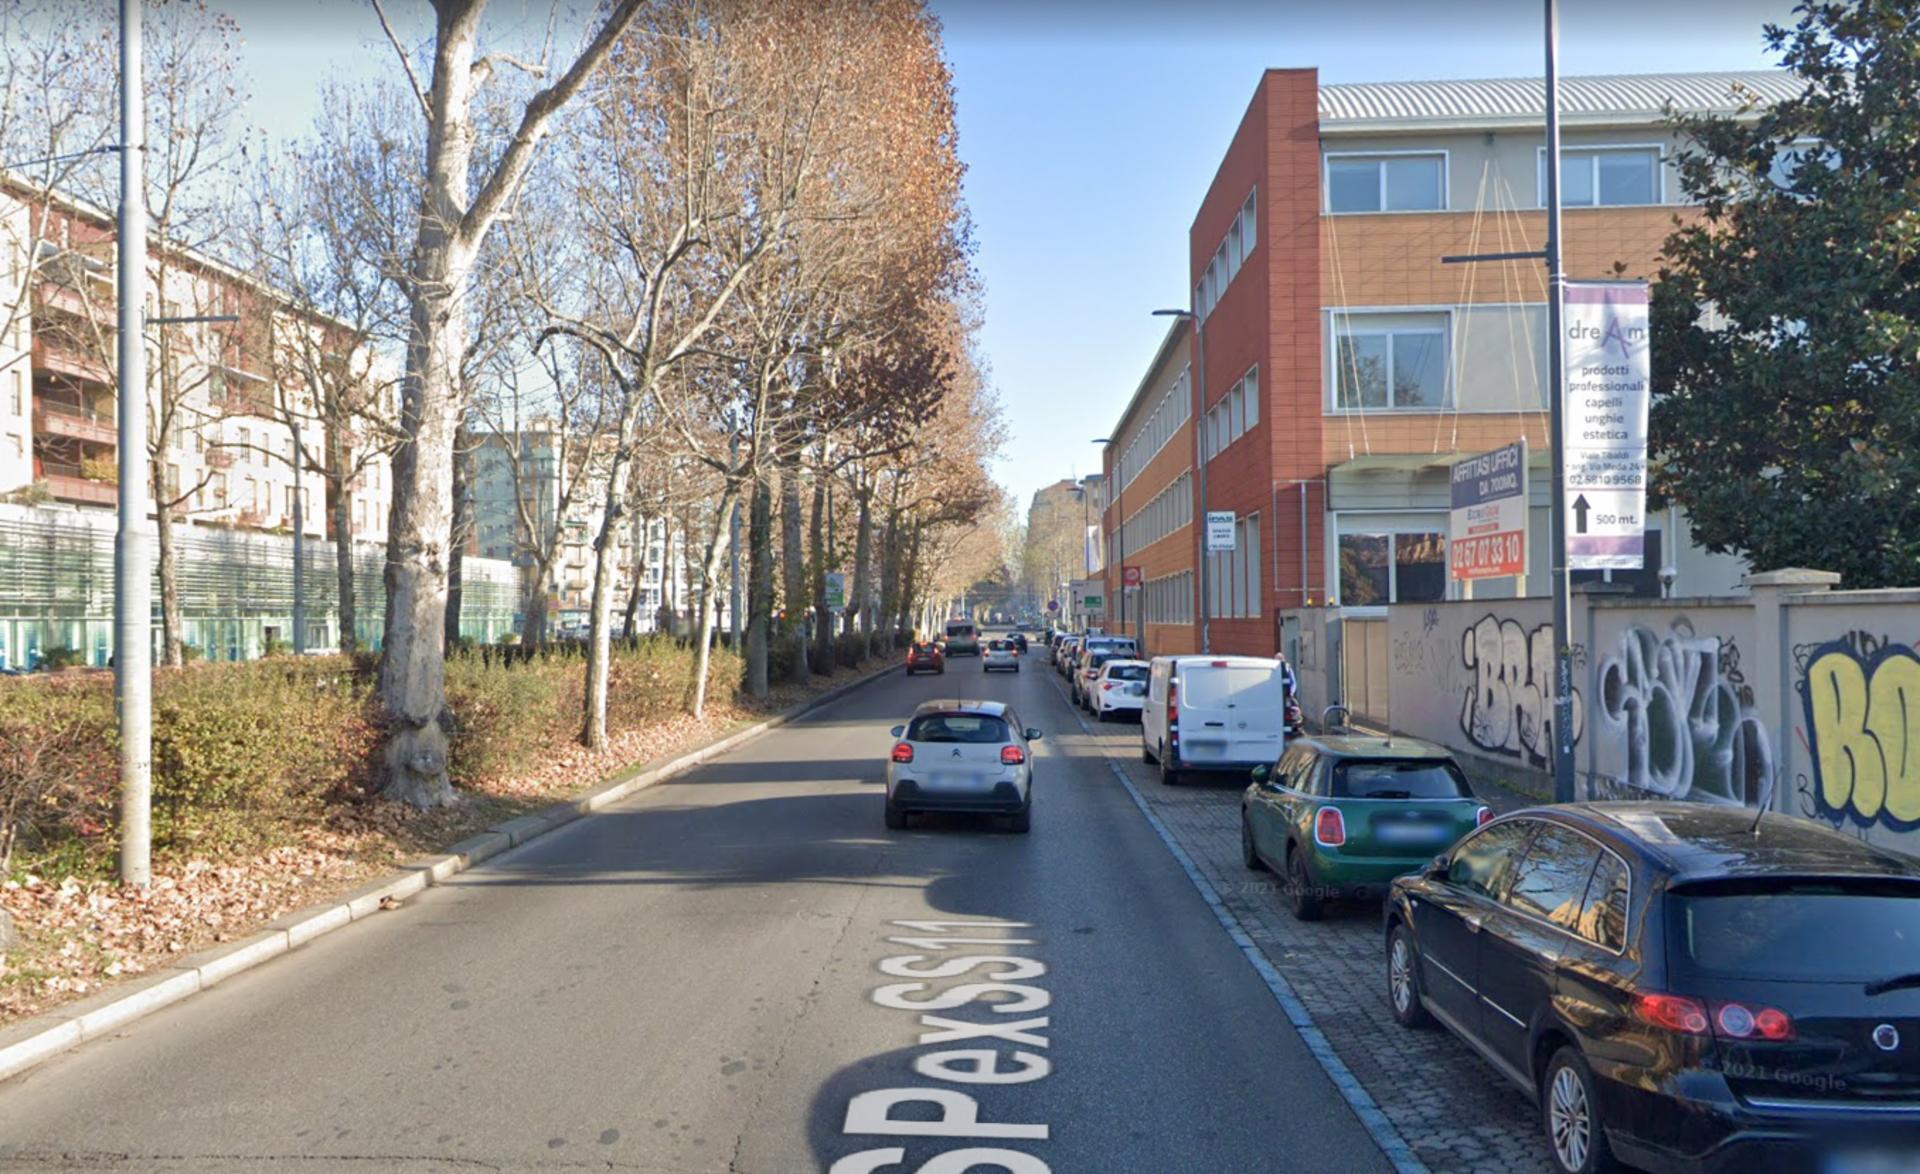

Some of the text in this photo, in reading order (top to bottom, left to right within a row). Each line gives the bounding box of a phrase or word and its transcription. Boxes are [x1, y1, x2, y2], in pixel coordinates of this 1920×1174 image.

[1582, 365, 1630, 377] prodotti
[1568, 380, 1645, 393] professionali
[1585, 397, 1623, 409] capelli
[1584, 413, 1625, 427] unghie
[1582, 429, 1629, 441] estetica
[1595, 514, 1639, 526] 500 mt.
[1506, 533, 1520, 563] 10
